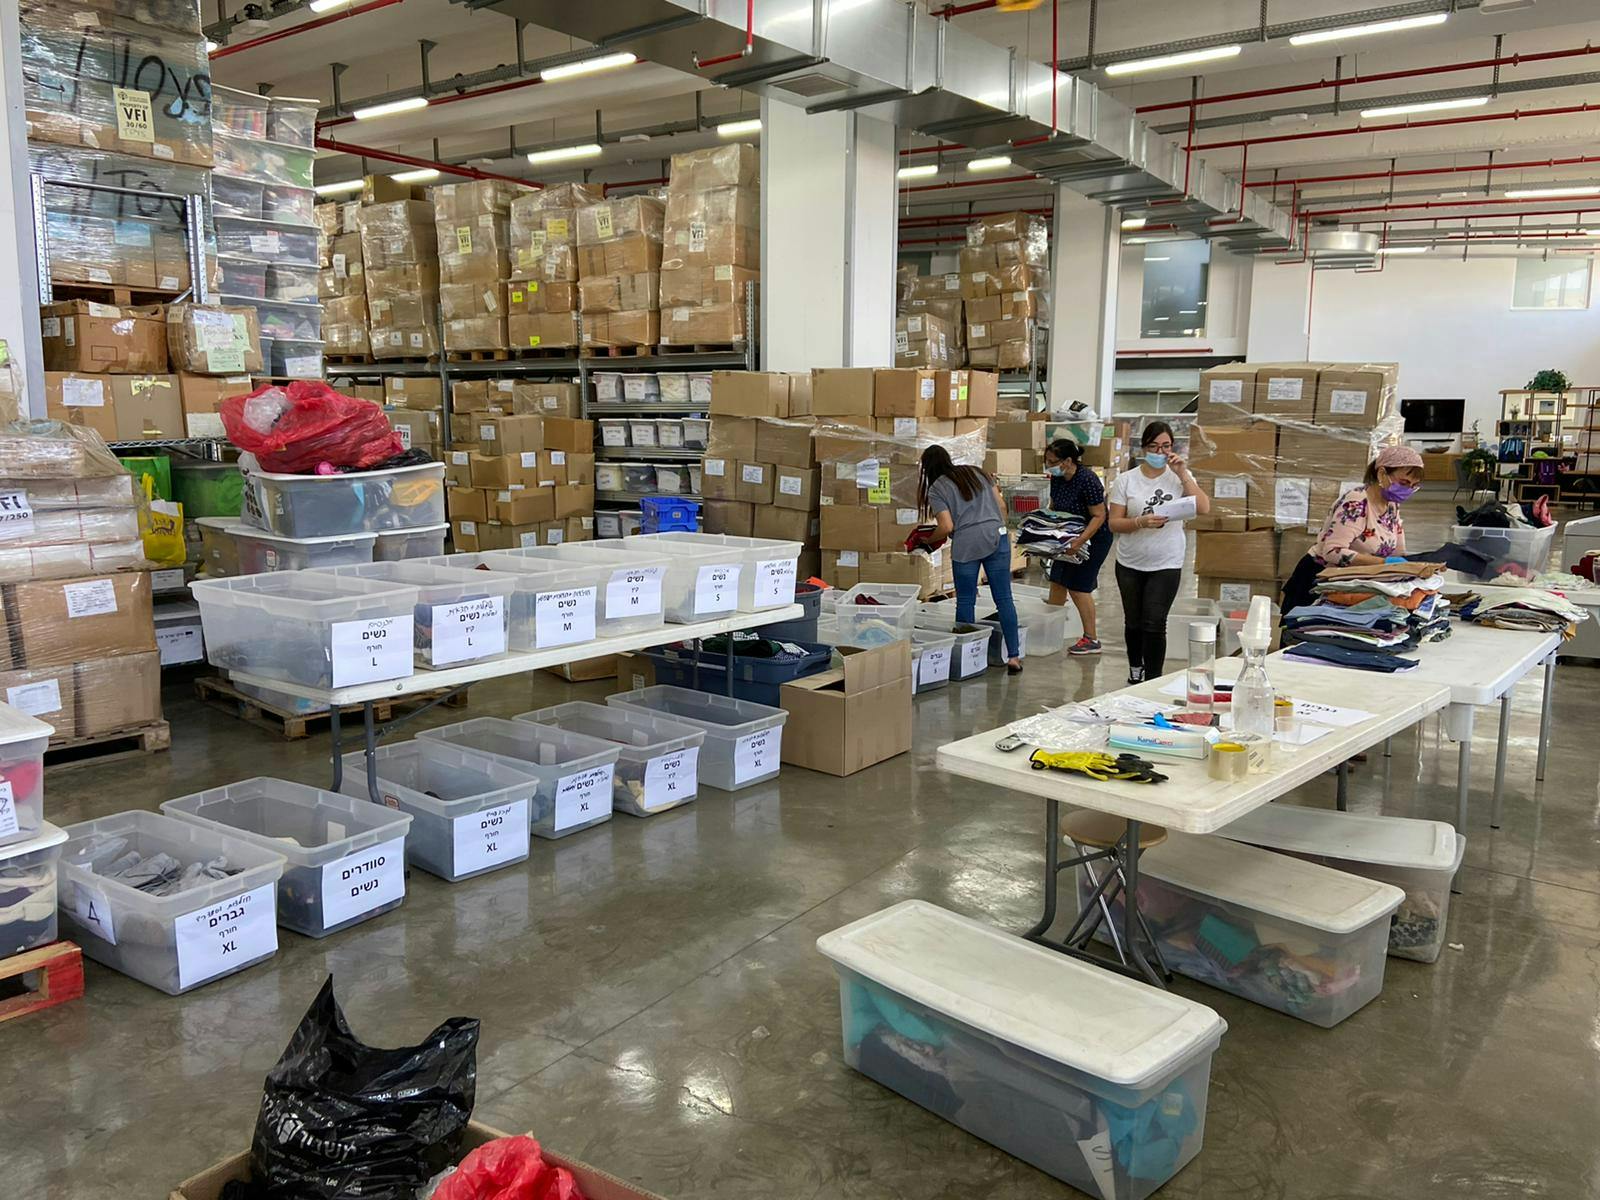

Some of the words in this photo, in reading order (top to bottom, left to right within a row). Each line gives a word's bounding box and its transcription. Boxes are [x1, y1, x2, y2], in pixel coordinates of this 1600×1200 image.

[123, 107, 147, 122] VFI
[691, 229, 704, 239] VFI
[0, 495, 22, 510] FI
[774, 587, 778, 595] S
[631, 596, 639, 605] M
[715, 593, 721, 602] S
[558, 599, 577, 608] נשים
[459, 611, 480, 622] נשים
[563, 622, 572, 631] M
[362, 629, 387, 640] נשים
[467, 637, 473, 646] L
[366, 644, 383, 652] חורף
[372, 657, 378, 666] L
[751, 738, 766, 749] נשים
[754, 759, 762, 768] XL
[576, 778, 594, 790] נשים
[667, 781, 676, 791] XL
[580, 802, 590, 812] XL
[481, 816, 503, 830] נשים
[484, 830, 499, 840] חורף
[486, 842, 498, 853] XL
[341, 856, 386, 881] סוודרים
[351, 878, 379, 897] נשים
[208, 906, 246, 928] גברים
[218, 925, 238, 939] חורף
[222, 940, 238, 955] XL
